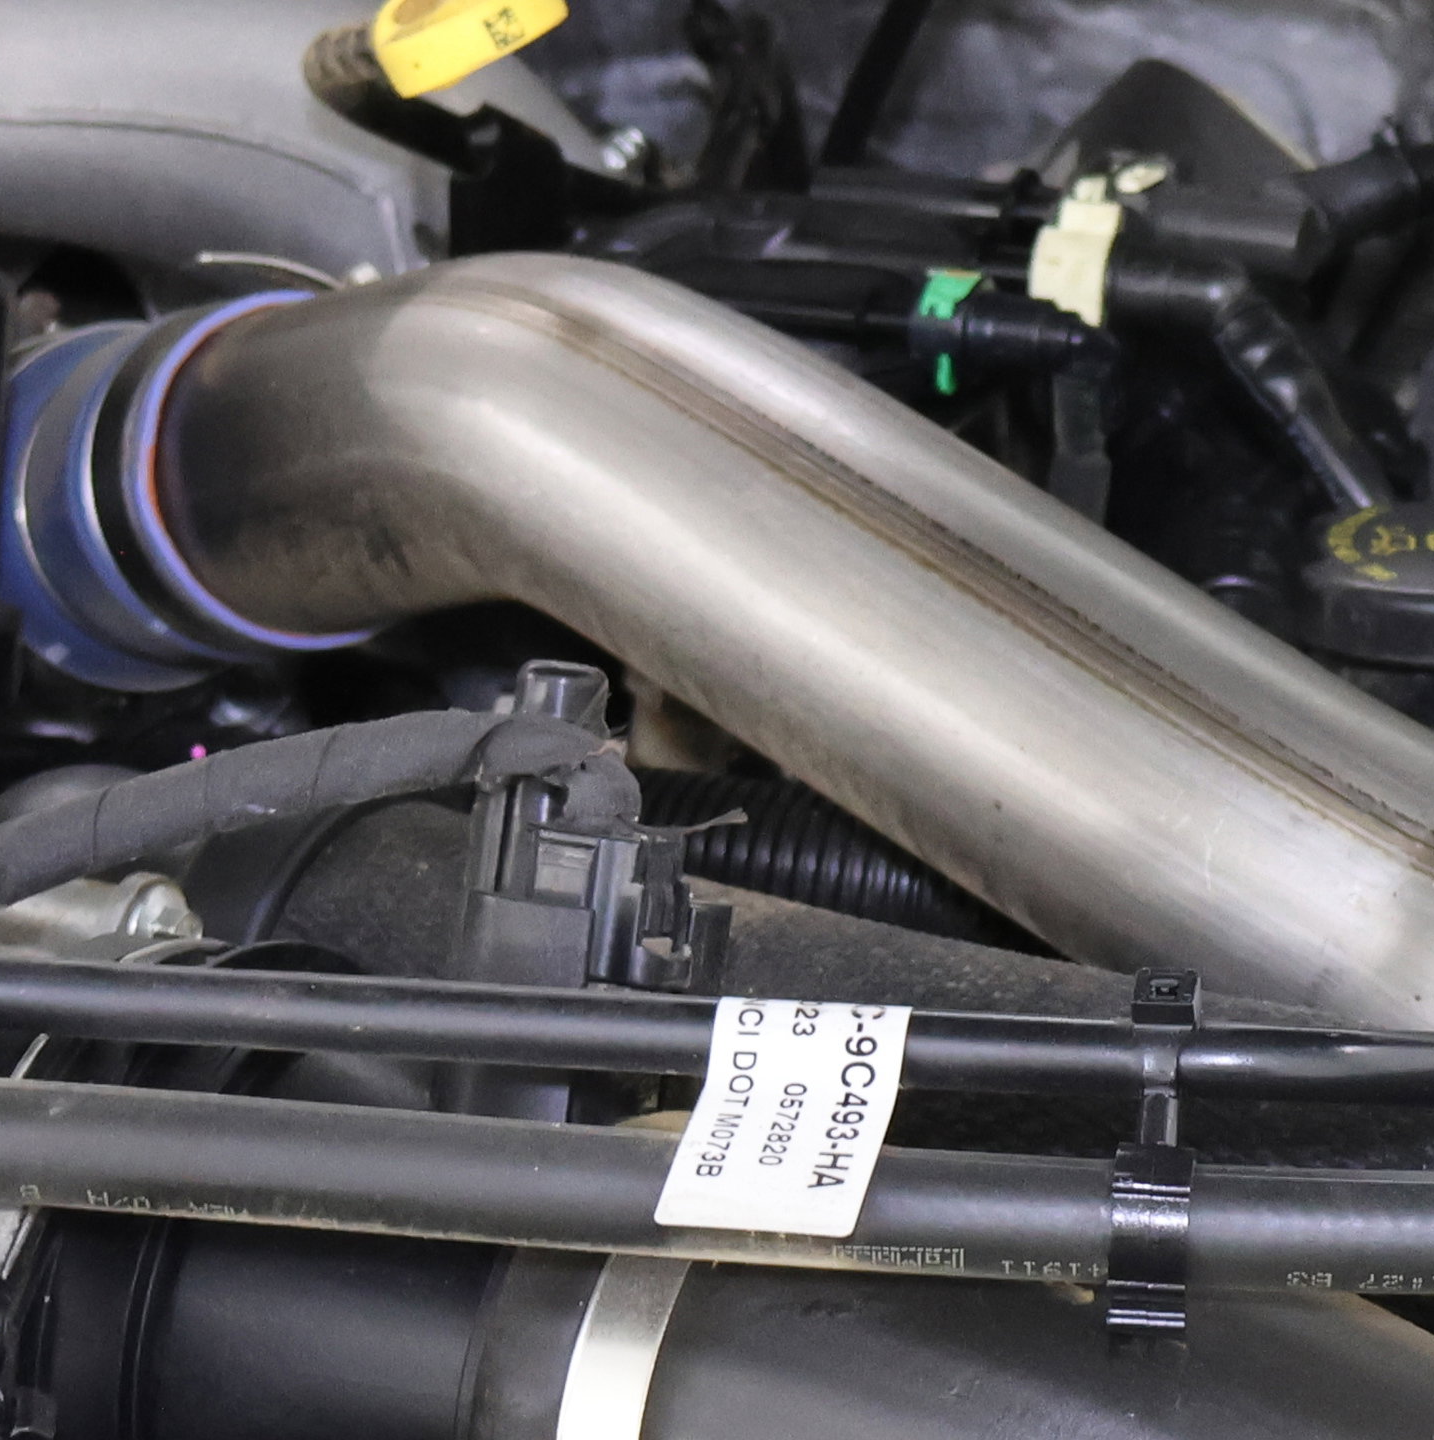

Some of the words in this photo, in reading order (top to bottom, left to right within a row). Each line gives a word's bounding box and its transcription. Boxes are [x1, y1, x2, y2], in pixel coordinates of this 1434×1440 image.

[791, 999, 823, 1037] 23
[724, 1051, 758, 1107] DOT
[695, 1113, 744, 1178] M073B
[758, 1083, 808, 1166] 0572820
